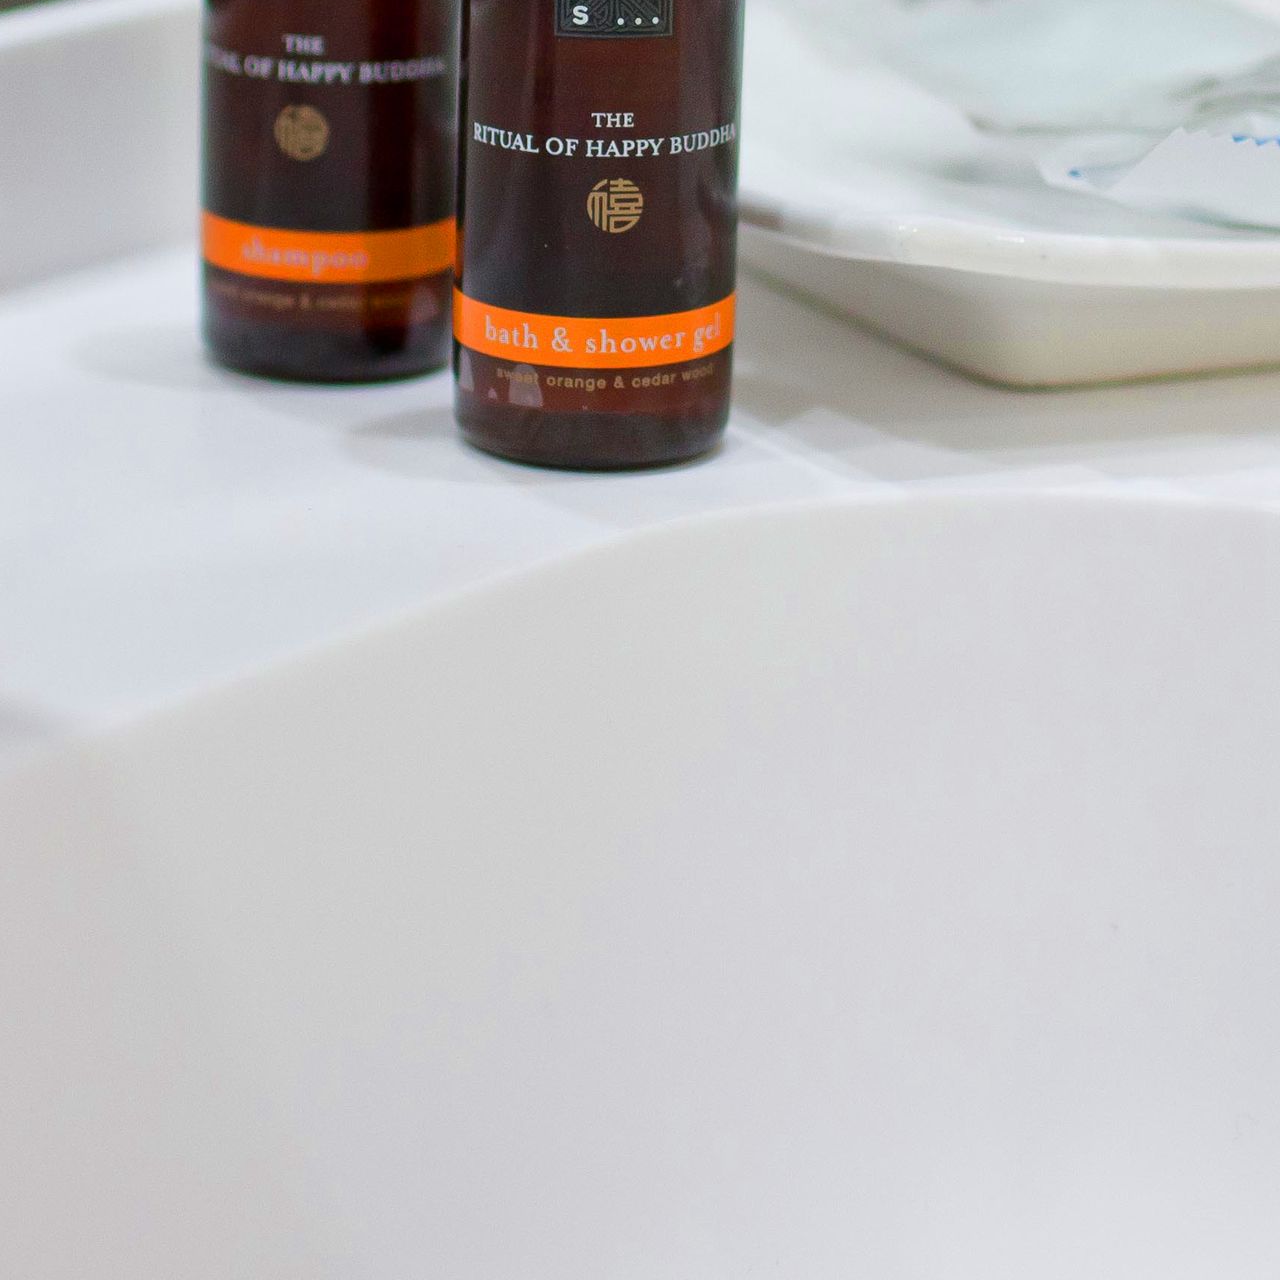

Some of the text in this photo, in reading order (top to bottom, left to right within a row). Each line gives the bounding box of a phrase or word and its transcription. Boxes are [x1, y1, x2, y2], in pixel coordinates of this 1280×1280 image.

[281, 33, 325, 55] THE
[243, 54, 274, 78] OF
[277, 59, 355, 84] HAPPY
[591, 112, 635, 128] THE
[473, 121, 540, 155] RITUAL
[545, 136, 580, 157] OF
[585, 138, 665, 158] HAPPY
[484, 311, 721, 354] bath & shower gel
[546, 375, 607, 392] orange
[613, 375, 625, 389] &
[631, 371, 676, 388] cedar
